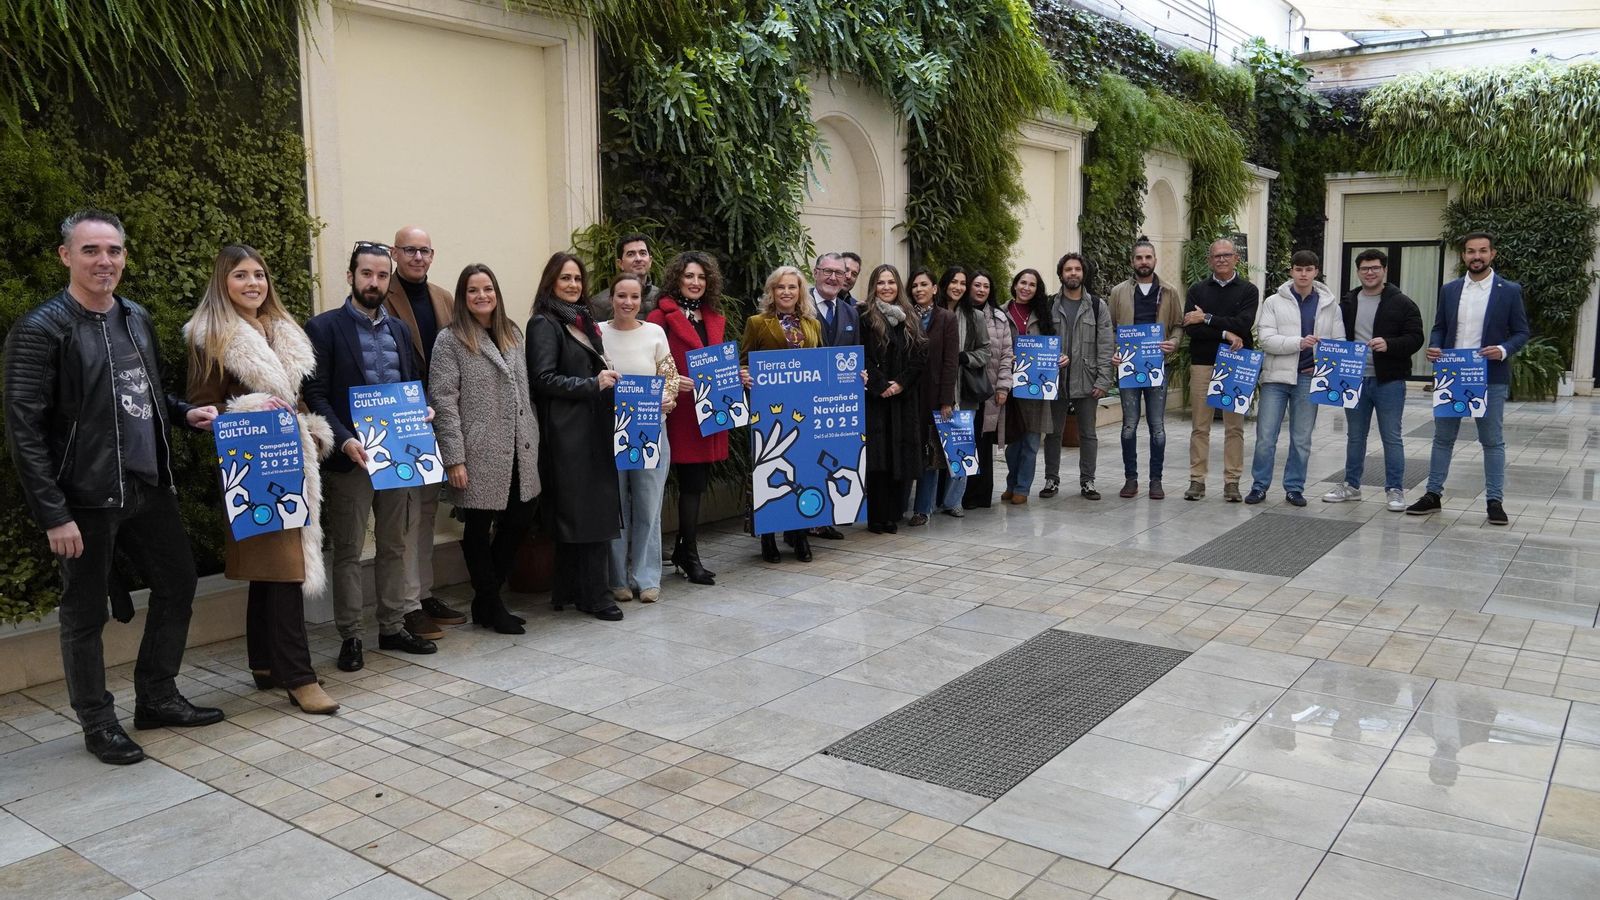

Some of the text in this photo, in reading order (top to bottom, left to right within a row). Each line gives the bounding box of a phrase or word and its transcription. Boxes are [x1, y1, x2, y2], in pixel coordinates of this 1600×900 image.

[1219, 351, 1244, 361] CULTURA
[690, 356, 718, 368] CULTURA
[757, 359, 801, 370] Tierra de
[715, 369, 738, 379] Navidad
[757, 370, 821, 385] CULTURA
[717, 376, 739, 386] 2025
[354, 397, 397, 408] CULTURA
[813, 394, 848, 403] Campaña
[814, 403, 858, 415] Navidad
[218, 421, 237, 429] Tierra
[394, 416, 425, 425] Navidad
[814, 416, 858, 430] 2025
[219, 426, 268, 439] CULTURA
[396, 423, 428, 433] 2025
[260, 442, 289, 450] Campaña
[260, 448, 298, 458] Navidad
[261, 456, 299, 469] 2025
